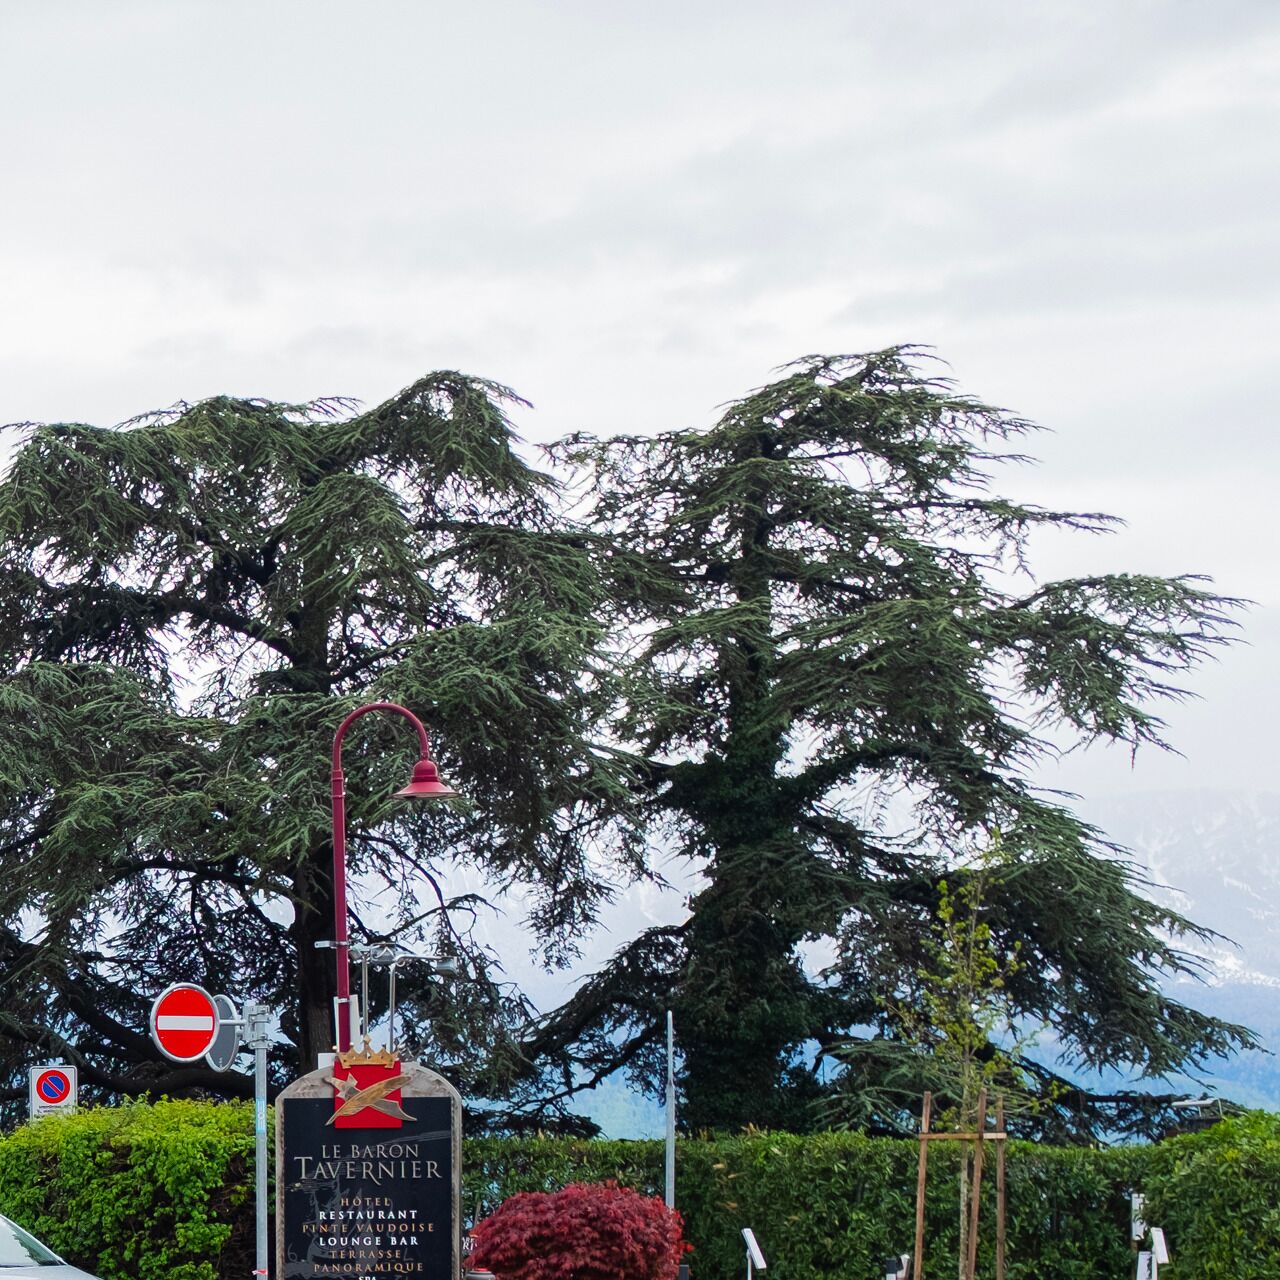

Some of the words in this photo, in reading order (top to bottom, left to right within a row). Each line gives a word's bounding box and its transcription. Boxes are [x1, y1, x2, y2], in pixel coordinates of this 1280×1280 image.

[322, 1144, 341, 1159] LE
[351, 1144, 419, 1158] BARON
[293, 1156, 443, 1186] TAVERNIER
[319, 1210, 418, 1220] RESTAURANT
[302, 1224, 348, 1233] PINTE
[356, 1223, 435, 1233] VAUDOISE
[319, 1237, 382, 1247] LOUNGE
[390, 1236, 419, 1246] BAR
[330, 1250, 401, 1260] TERRASSE
[314, 1262, 424, 1274] PANORAMIQUE
